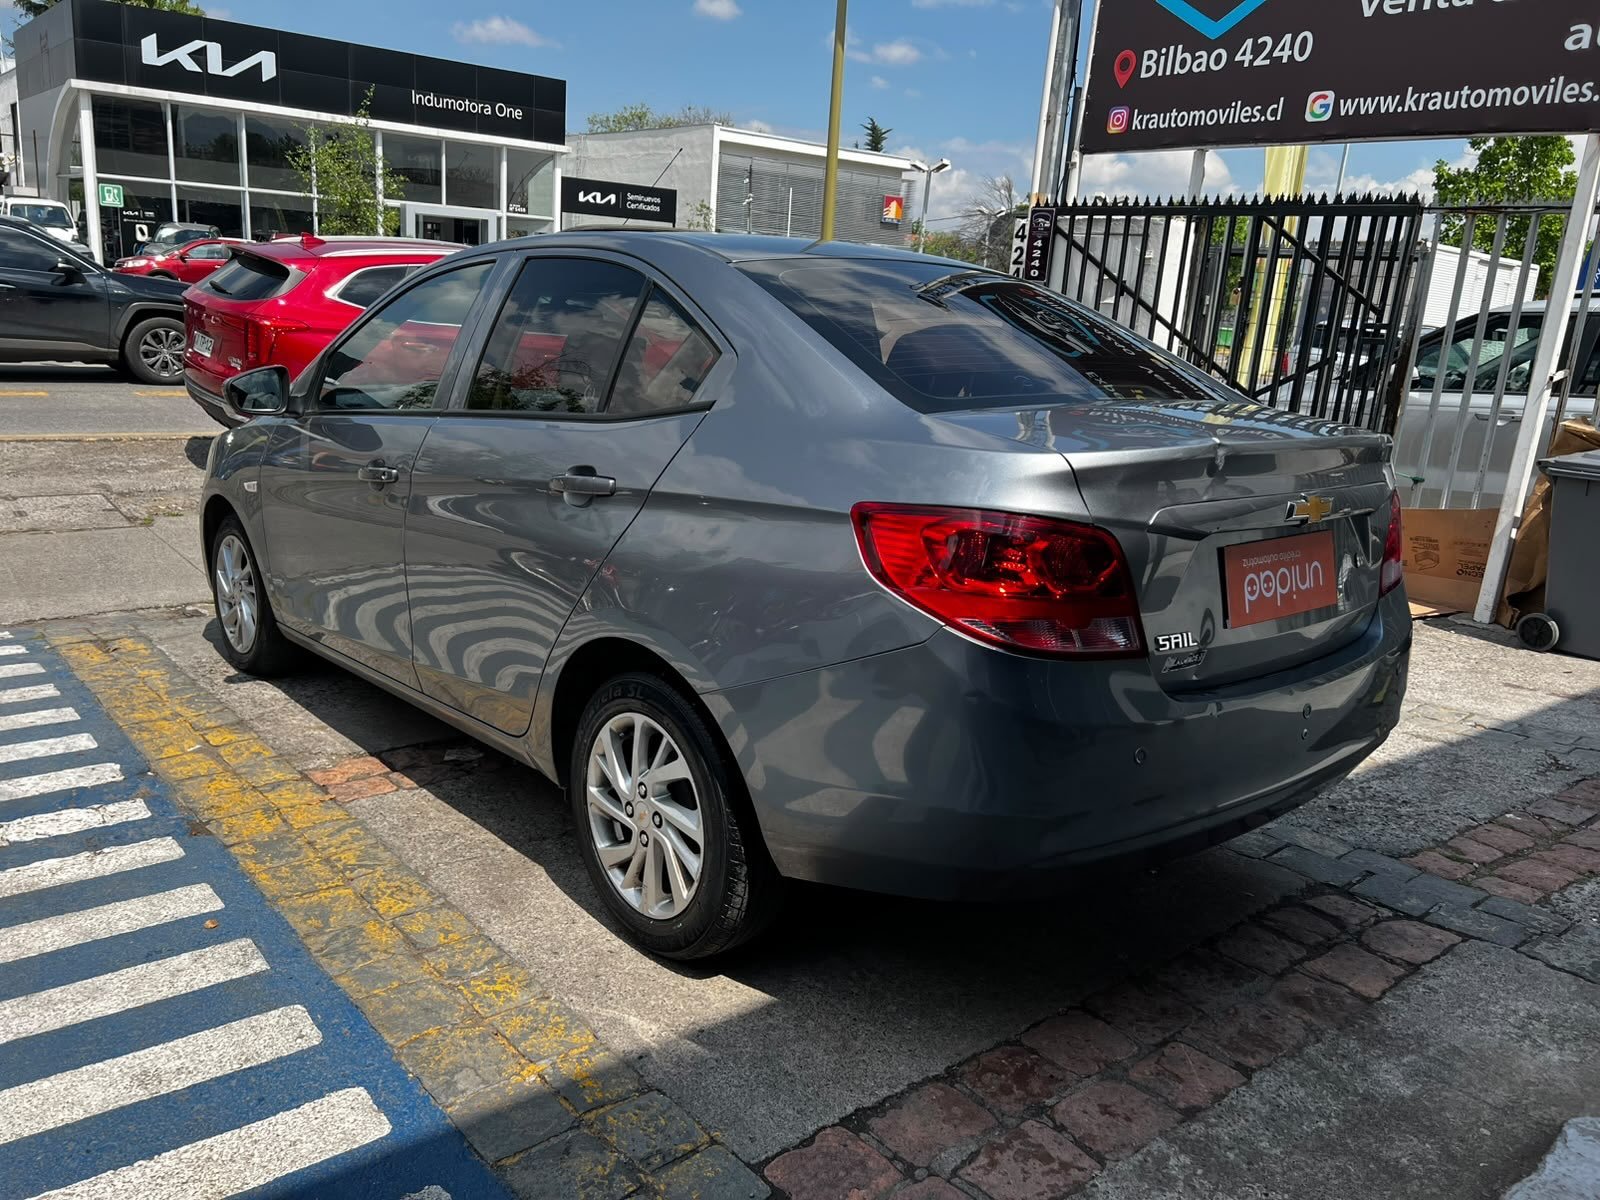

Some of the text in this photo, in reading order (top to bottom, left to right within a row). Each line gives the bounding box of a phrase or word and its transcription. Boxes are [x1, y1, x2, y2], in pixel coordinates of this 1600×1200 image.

[1564, 23, 1600, 50] a
[141, 32, 277, 82] KIA
[1140, 30, 1313, 79] Bilbao 4240
[411, 89, 523, 120] Indumotora One
[1131, 97, 1285, 131] krautomoviles.cl
[578, 190, 617, 206] KIA
[1030, 239, 1043, 277] 4240
[1244, 560, 1323, 614] unidad
[1456, 568, 1485, 578] ECNO
[1157, 632, 1198, 651] SAIL
